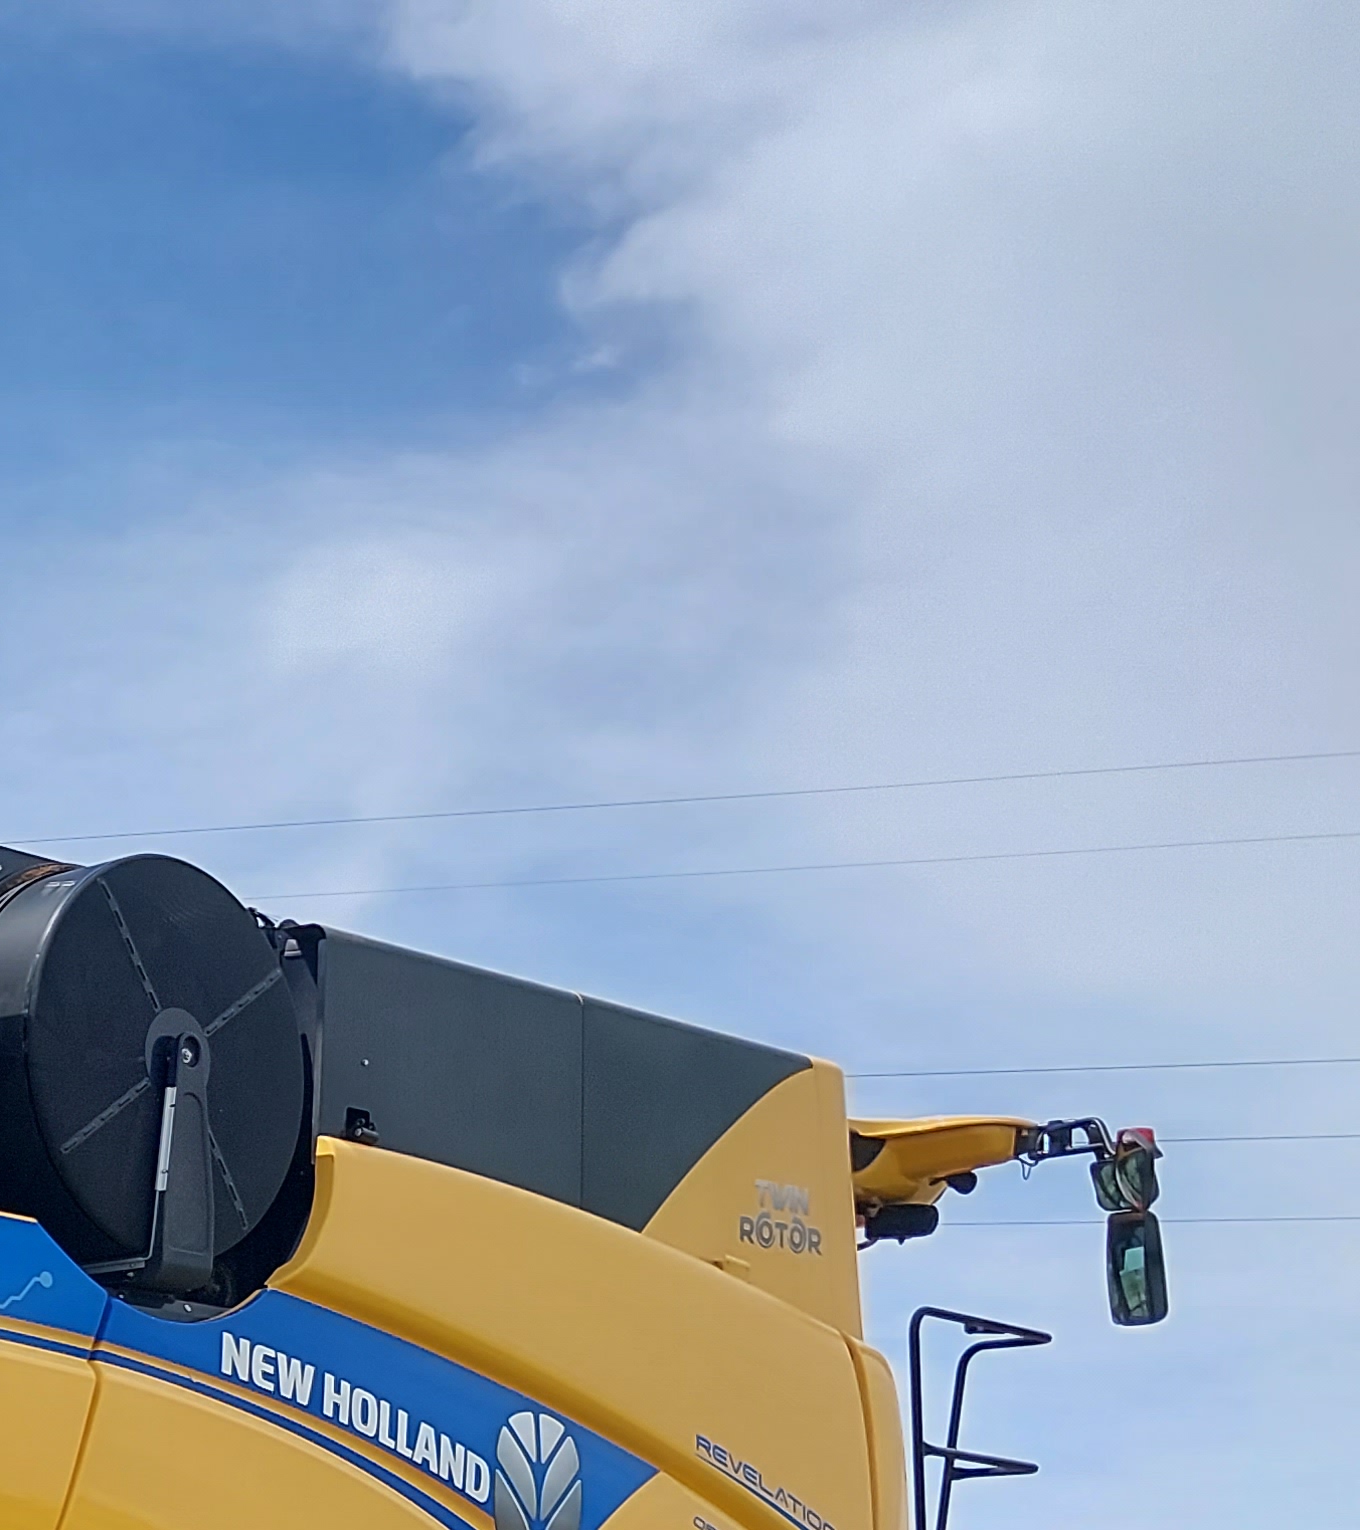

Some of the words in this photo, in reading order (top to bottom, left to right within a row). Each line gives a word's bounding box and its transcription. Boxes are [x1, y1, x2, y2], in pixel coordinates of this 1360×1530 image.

[754, 1179, 808, 1216] TWIN
[740, 1211, 822, 1256] ROTOR
[221, 1331, 315, 1406] NEW
[323, 1372, 491, 1503] HOLLAND
